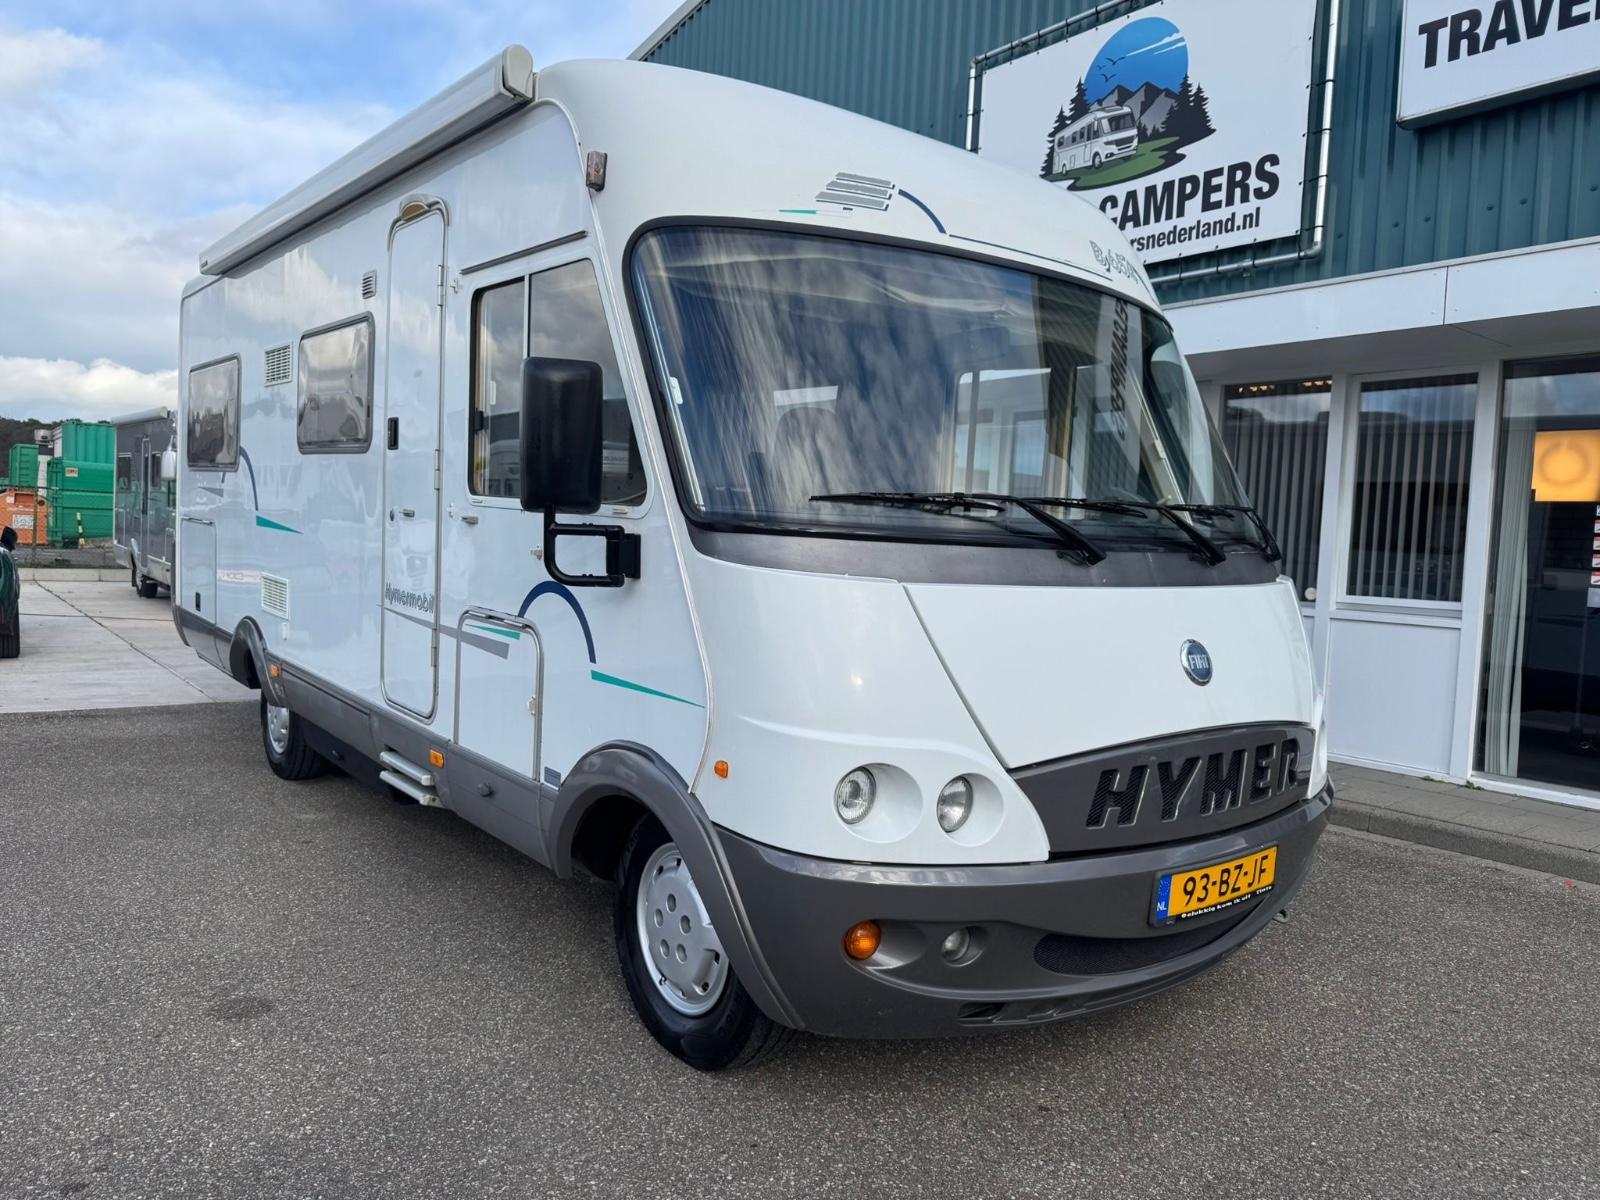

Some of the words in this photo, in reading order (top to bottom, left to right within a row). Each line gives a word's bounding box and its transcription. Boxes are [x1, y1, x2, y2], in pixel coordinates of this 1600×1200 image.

[1418, 0, 1600, 69] TRAVE
[1085, 737, 1301, 829] HYMER
[1156, 901, 1168, 912] NL
[1182, 854, 1269, 907] 93-BZ-JF
